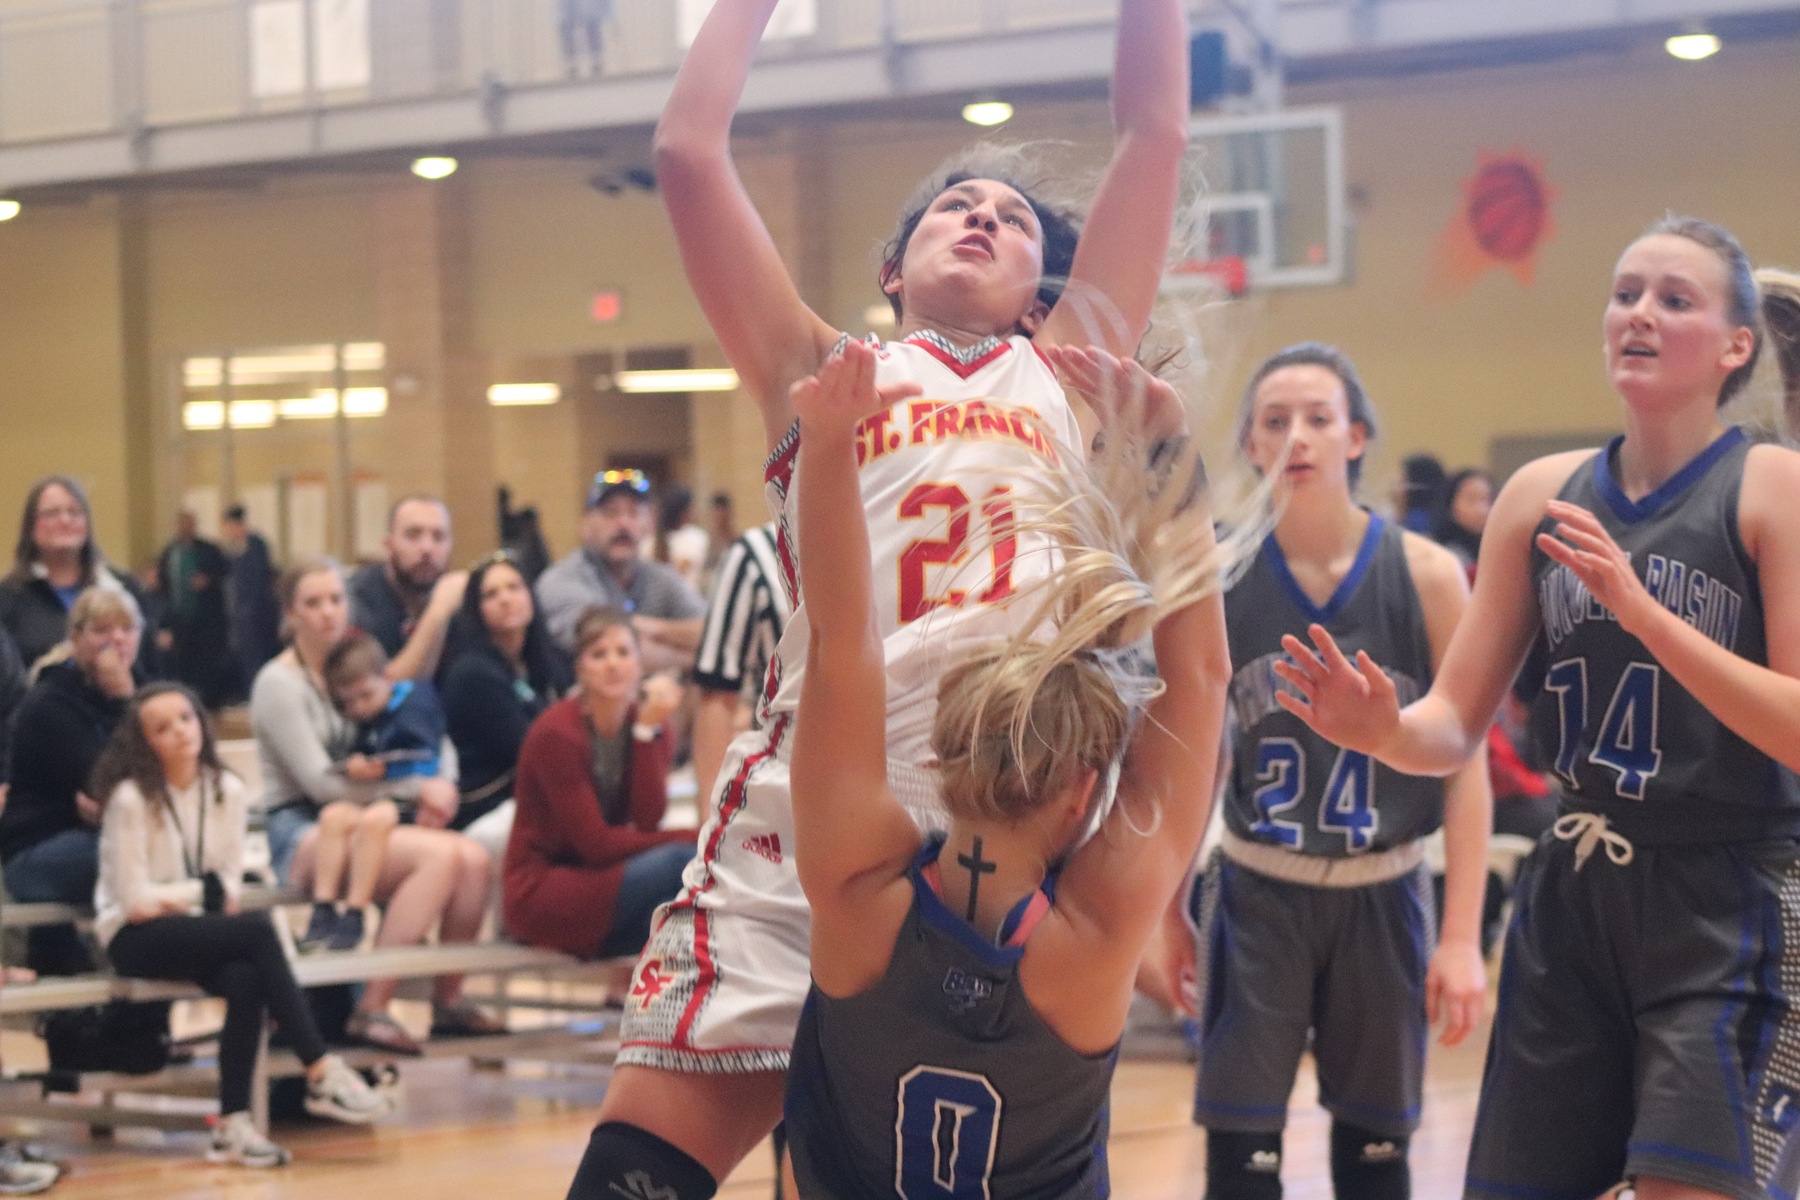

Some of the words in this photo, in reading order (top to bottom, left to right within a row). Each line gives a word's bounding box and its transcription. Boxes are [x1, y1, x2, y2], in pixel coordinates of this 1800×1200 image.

[897, 481, 1017, 624] 21
[1250, 735, 1379, 854] 24
[1545, 657, 1661, 800] 14
[895, 1064, 1002, 1200] 0
